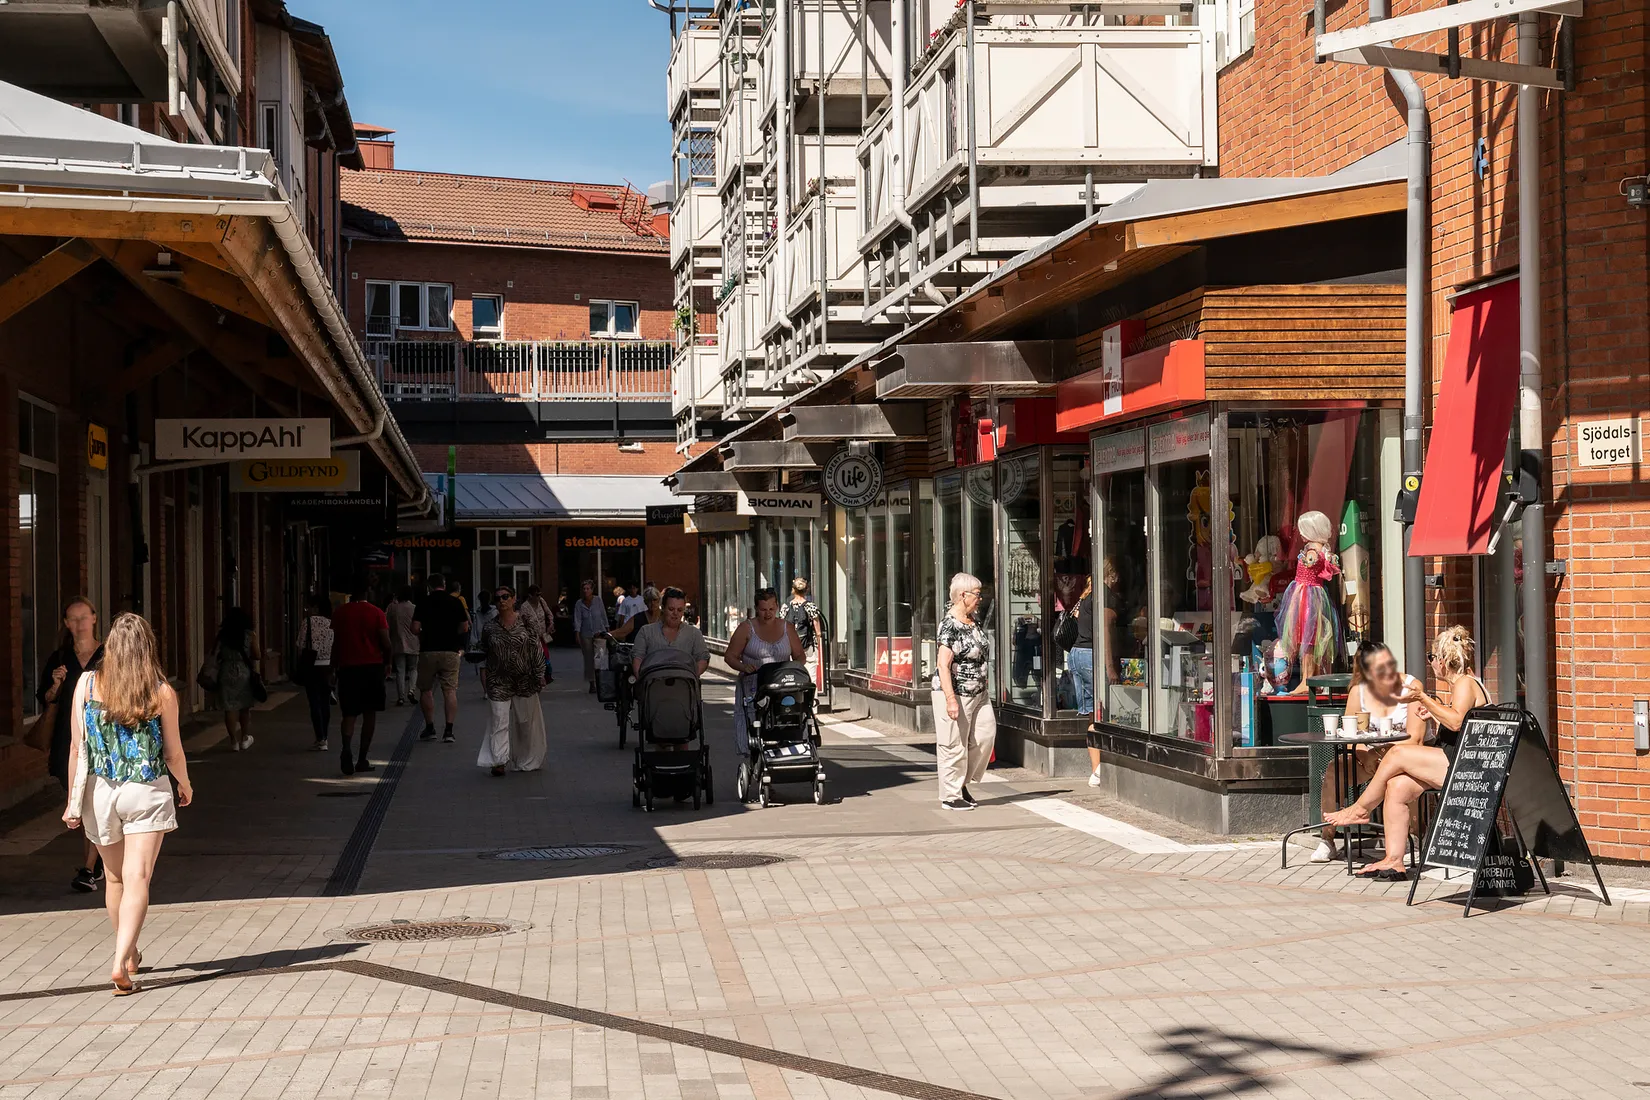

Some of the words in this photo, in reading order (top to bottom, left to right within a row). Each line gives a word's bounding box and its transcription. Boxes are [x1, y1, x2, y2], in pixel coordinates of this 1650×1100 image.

[183, 426, 302, 453] KappAhl
[1583, 425, 1637, 443] Sjödals-
[1591, 445, 1630, 462] torget
[841, 465, 867, 489] life
[747, 497, 813, 509] SKOMAN
[565, 535, 639, 547] steakhouse
[1480, 867, 1515, 879] YRBENTA
